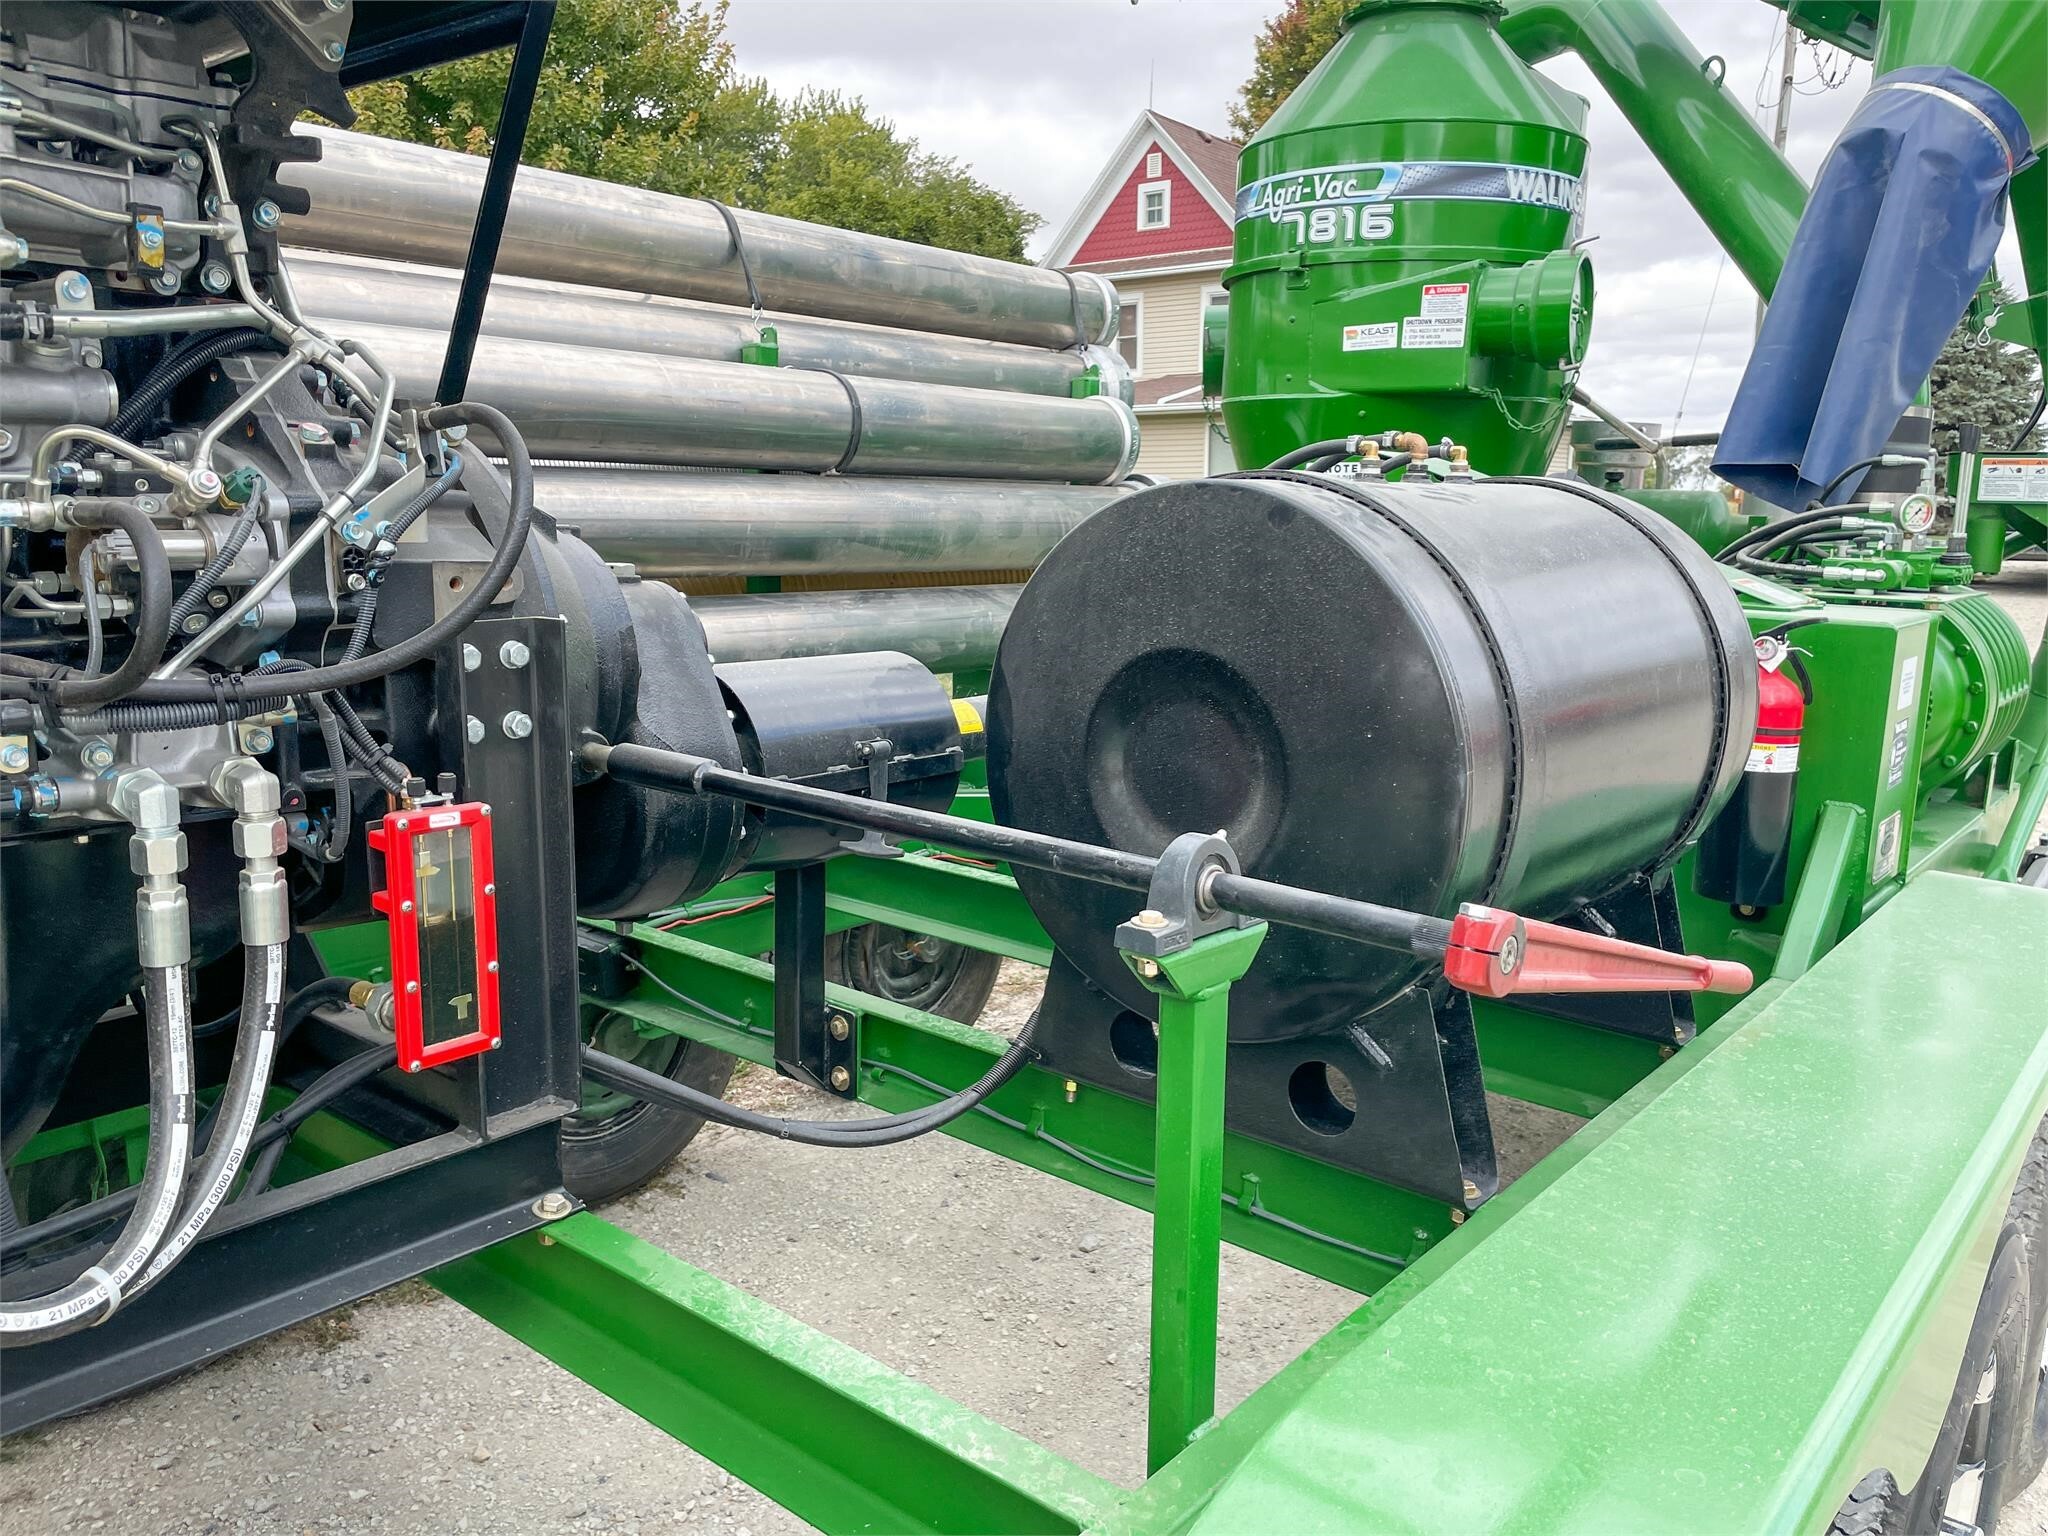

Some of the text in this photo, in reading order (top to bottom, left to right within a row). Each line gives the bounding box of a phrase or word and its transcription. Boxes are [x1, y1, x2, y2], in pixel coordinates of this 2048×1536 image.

[1261, 173, 1358, 223] Agri-Vac
[1281, 204, 1395, 245] 7816
[1436, 286, 1463, 294] DANGER
[1360, 326, 1396, 337] KEAST
[177, 1148, 243, 1246] 21 MPa (3000 PSI)
[48, 1308, 63, 1321] 21
[67, 1295, 95, 1315] MPa
[97, 1271, 128, 1299] (300
[128, 1245, 149, 1270] PSI)
